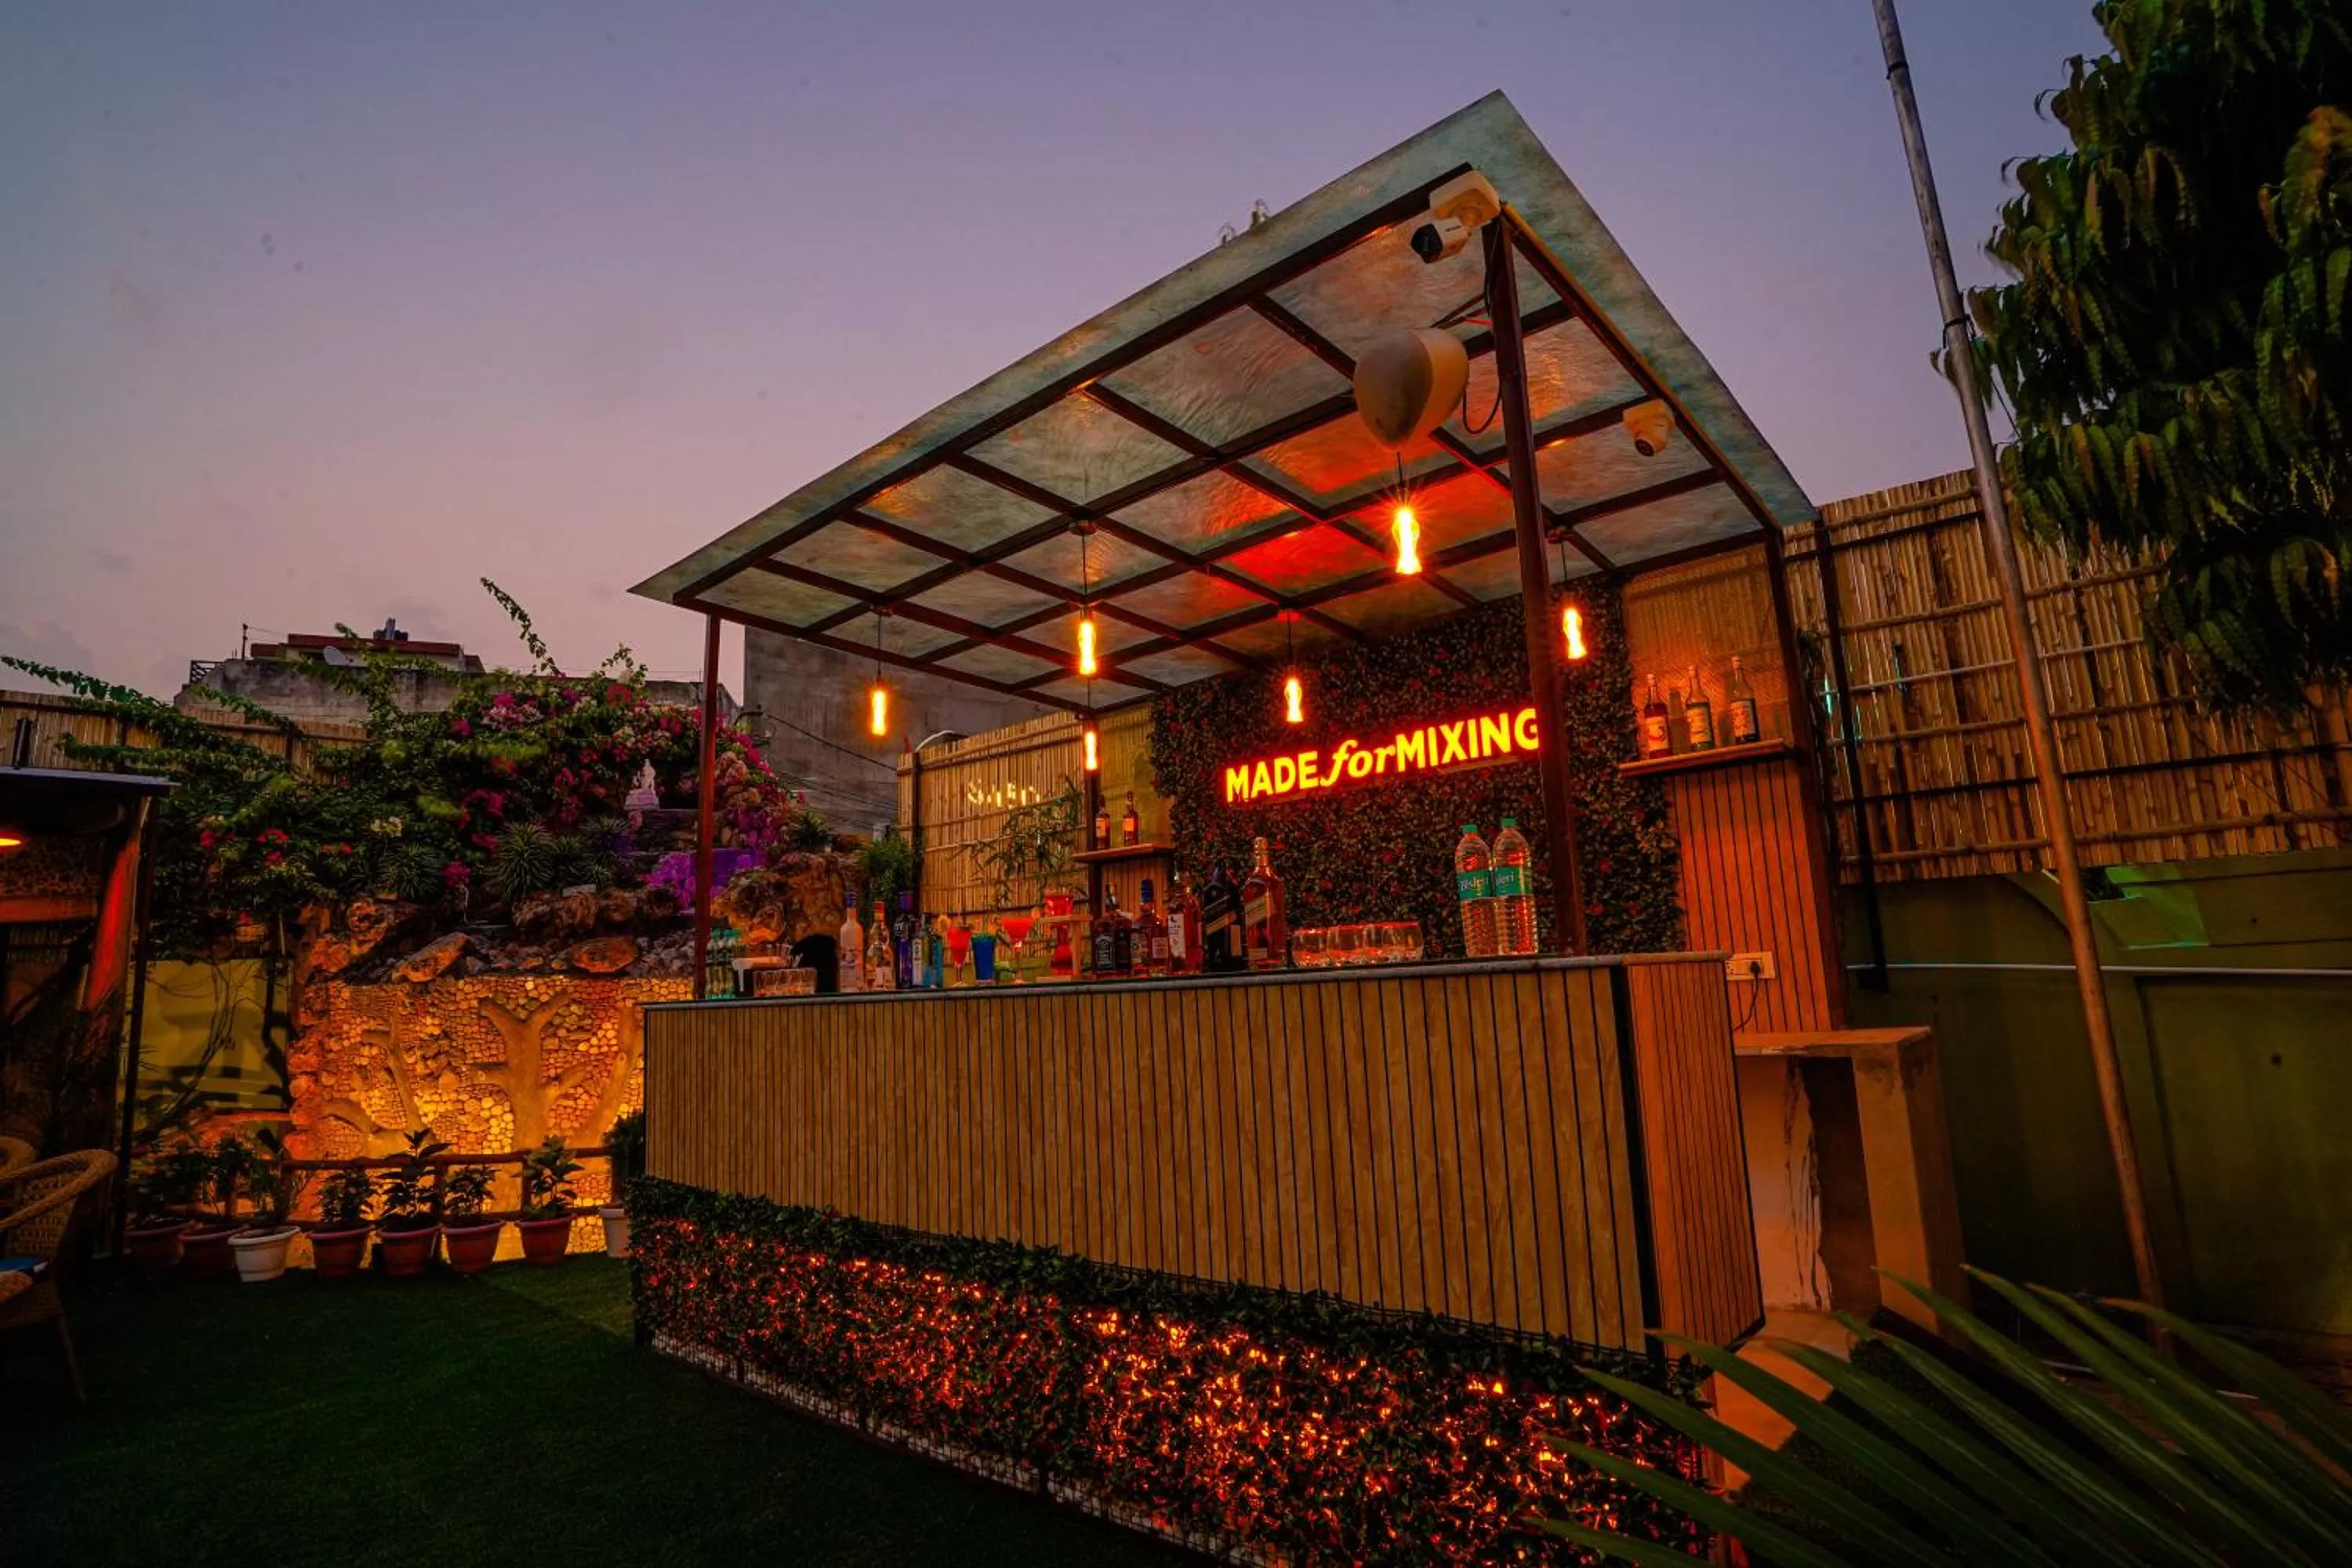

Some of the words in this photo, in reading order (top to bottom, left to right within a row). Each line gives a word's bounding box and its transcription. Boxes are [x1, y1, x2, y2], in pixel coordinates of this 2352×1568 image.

[1226, 750, 1319, 803] MADE
[1319, 739, 1396, 787] for
[1396, 708, 1540, 773] MIXING
